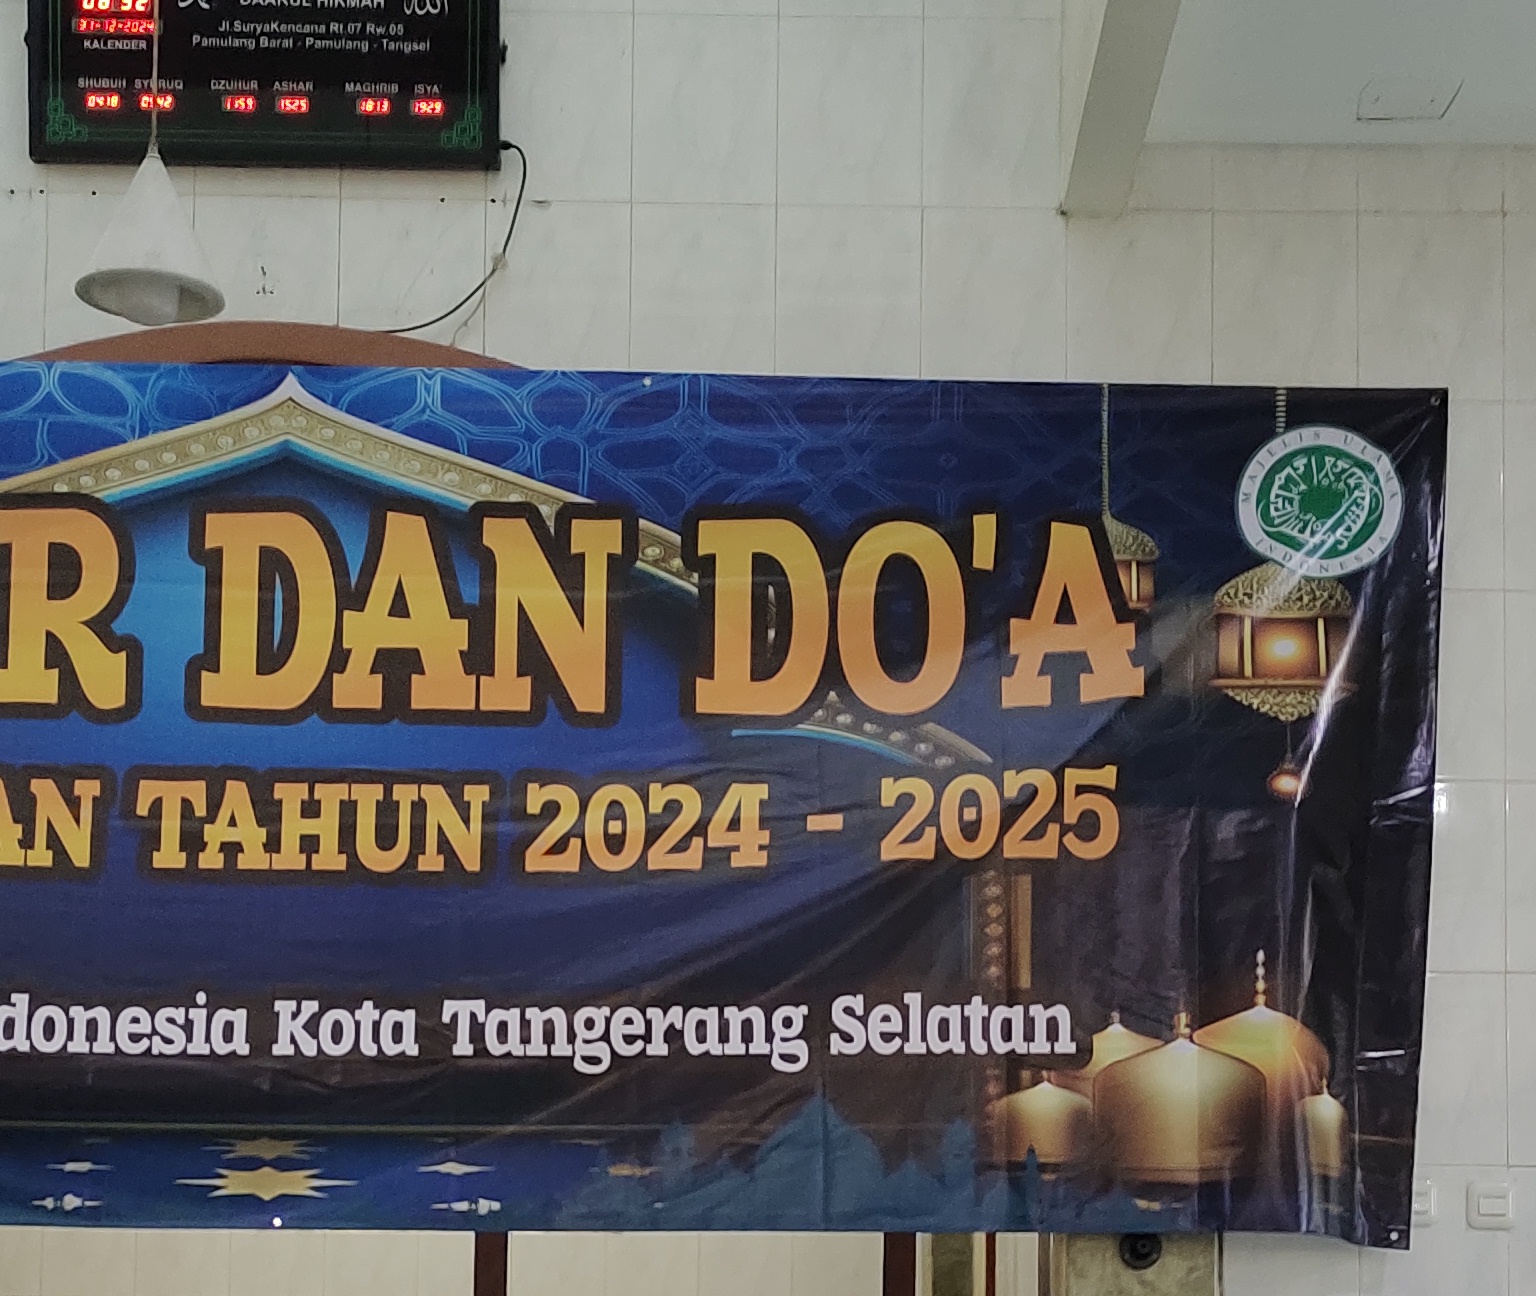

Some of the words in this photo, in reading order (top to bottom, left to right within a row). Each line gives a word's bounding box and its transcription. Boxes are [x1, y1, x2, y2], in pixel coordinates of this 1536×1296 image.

[83, 39, 147, 50] KALENDER
[305, 37, 369, 52] Pamulang
[272, 80, 314, 92] ASHAR
[345, 82, 399, 94] MAGHRIB
[198, 508, 623, 714] DAN
[695, 513, 1146, 716] DO'A
[135, 778, 490, 872] TAHUN
[524, 780, 769, 873] 2024
[806, 810, 845, 832] -
[879, 764, 1120, 861] 2025
[271, 997, 420, 1057] Kota
[440, 997, 809, 1073] Tangerang
[828, 992, 1076, 1056] Selatan
